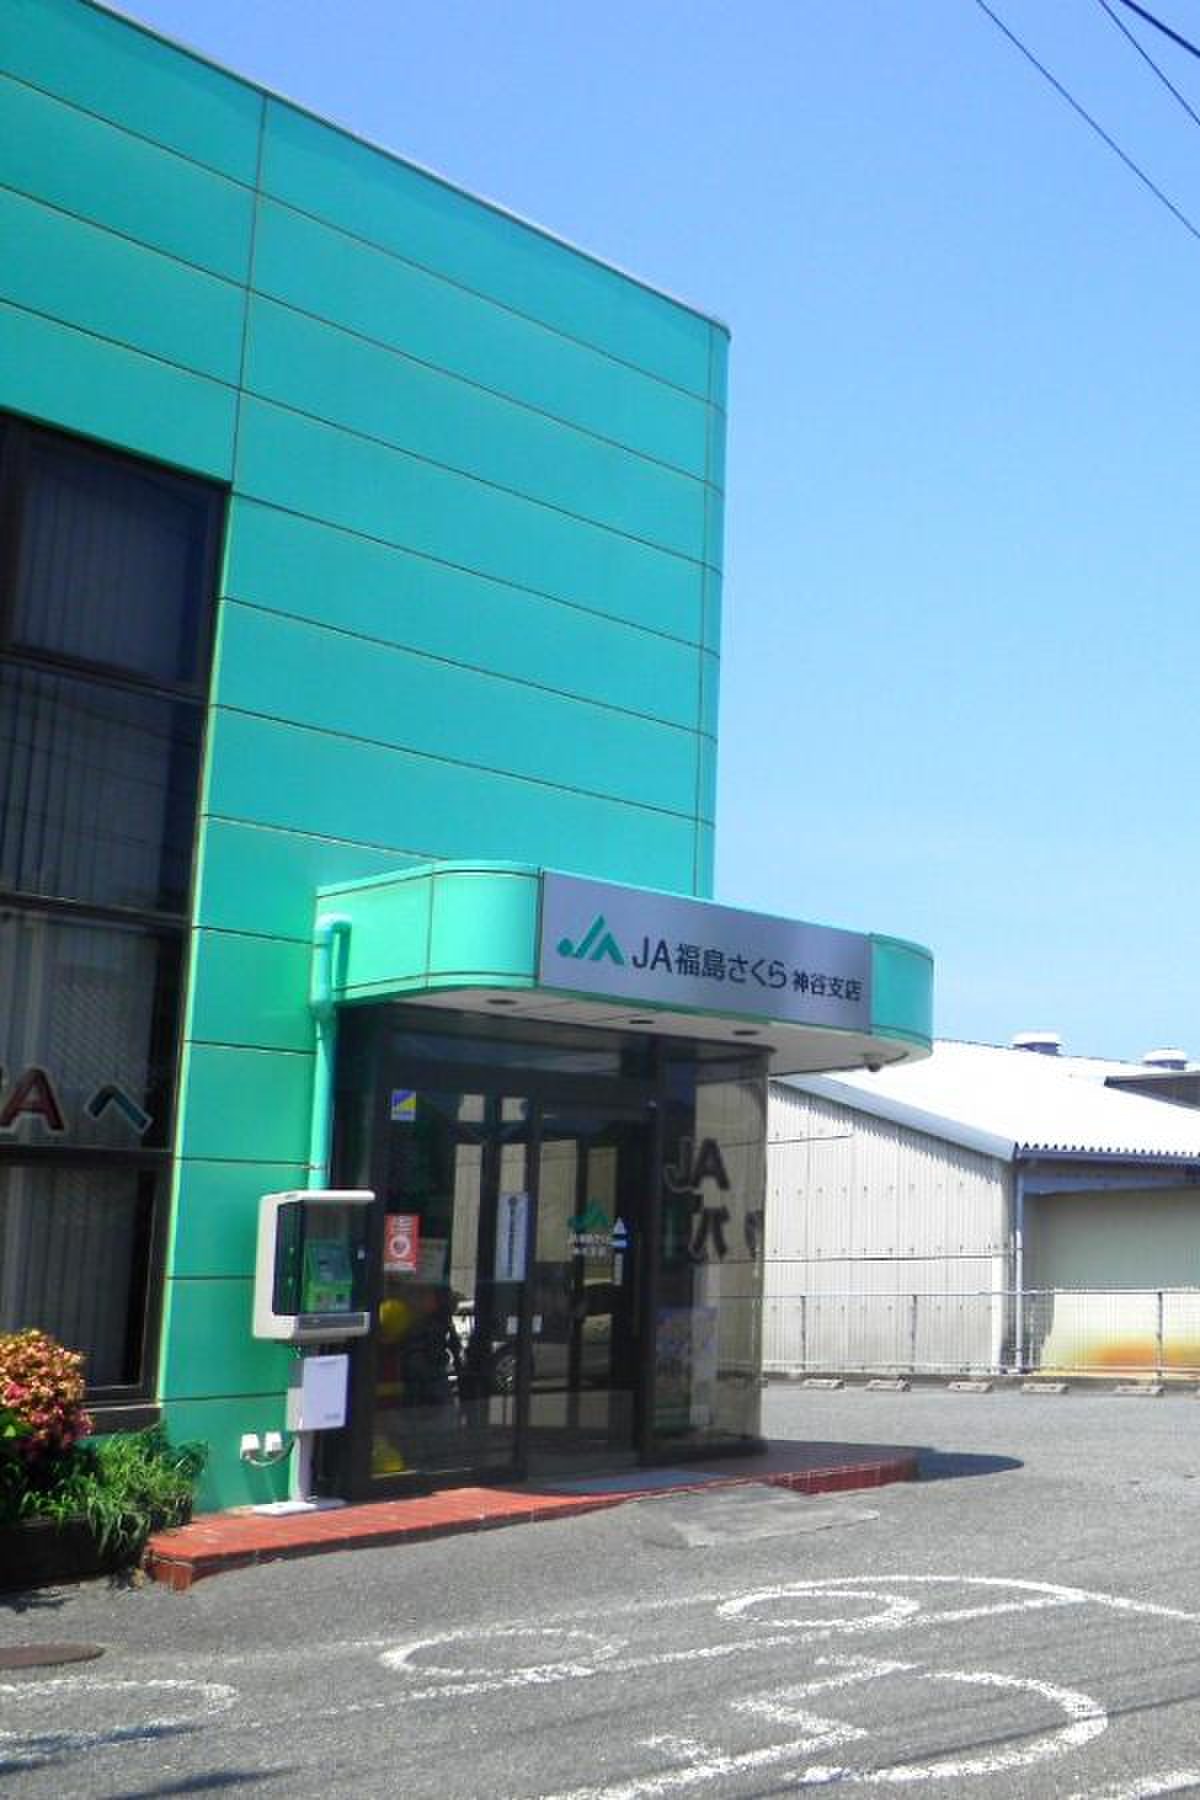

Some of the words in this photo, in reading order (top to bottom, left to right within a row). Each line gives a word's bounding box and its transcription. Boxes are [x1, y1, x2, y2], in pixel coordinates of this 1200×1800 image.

[632, 935, 788, 989] JA福島さくら
[792, 968, 865, 1001] 神谷支店
